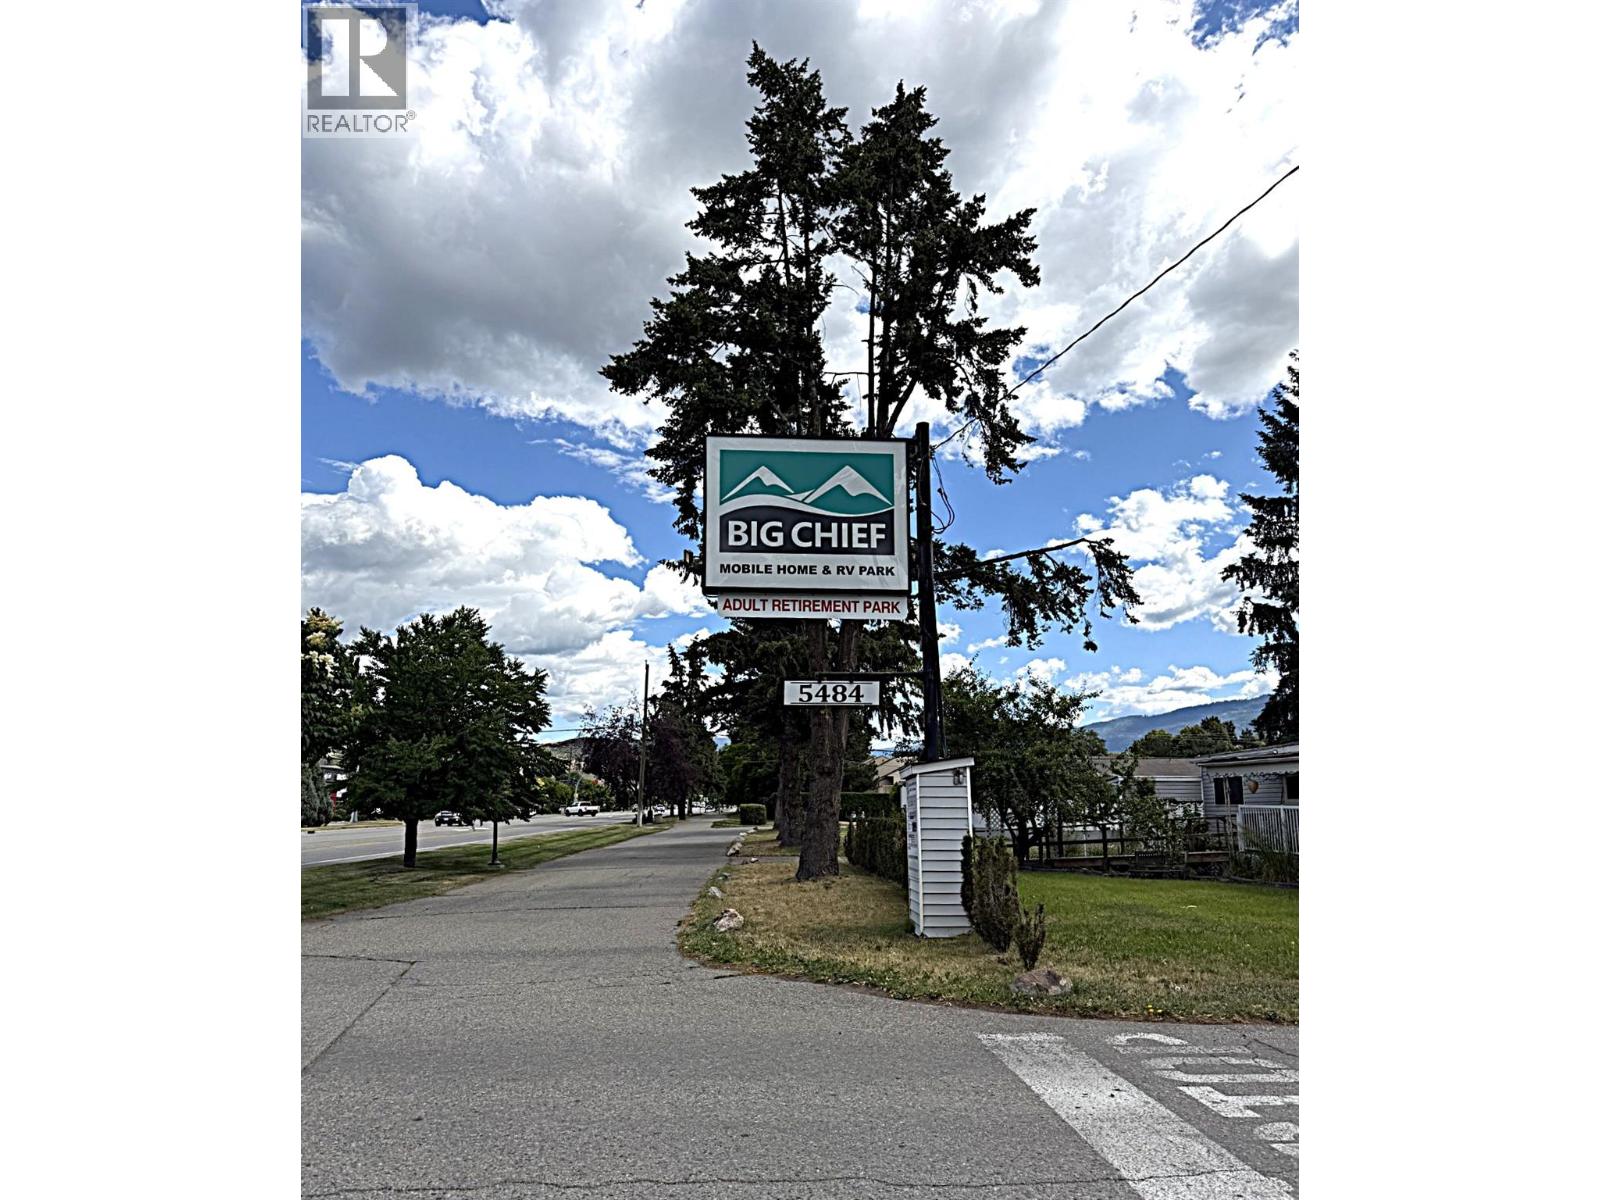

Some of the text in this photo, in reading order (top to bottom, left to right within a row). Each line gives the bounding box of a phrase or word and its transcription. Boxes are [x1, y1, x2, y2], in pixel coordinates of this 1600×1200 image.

[727, 520, 887, 549] BIG CHIEF
[719, 563, 896, 577] MOBILE HOME & RV PARK
[722, 598, 901, 614] ADULT RETIREMENT PARK
[798, 683, 865, 703] 5484
